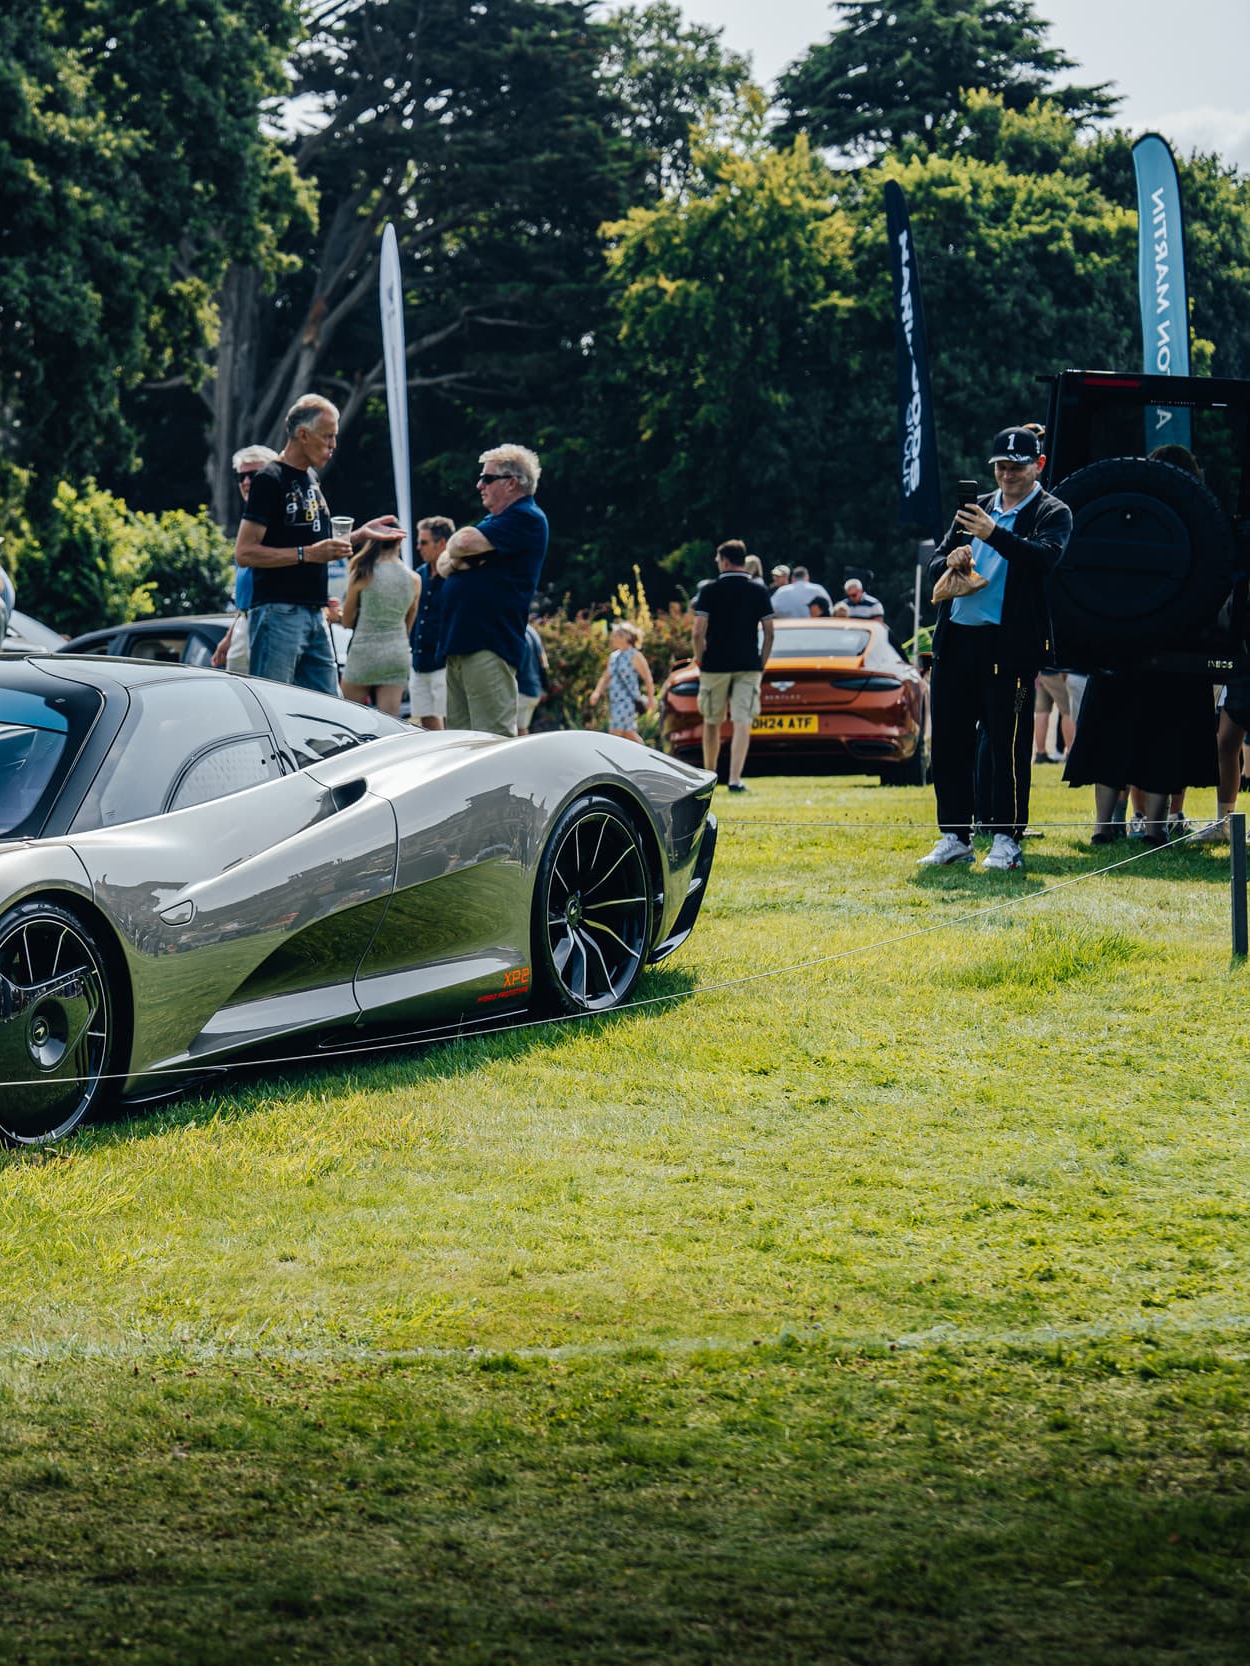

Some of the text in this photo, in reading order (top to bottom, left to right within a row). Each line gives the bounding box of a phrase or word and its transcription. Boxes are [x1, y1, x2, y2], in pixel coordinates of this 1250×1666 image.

[1007, 433, 1016, 450] 1
[788, 717, 813, 729] ATF
[502, 967, 531, 988] XP2
